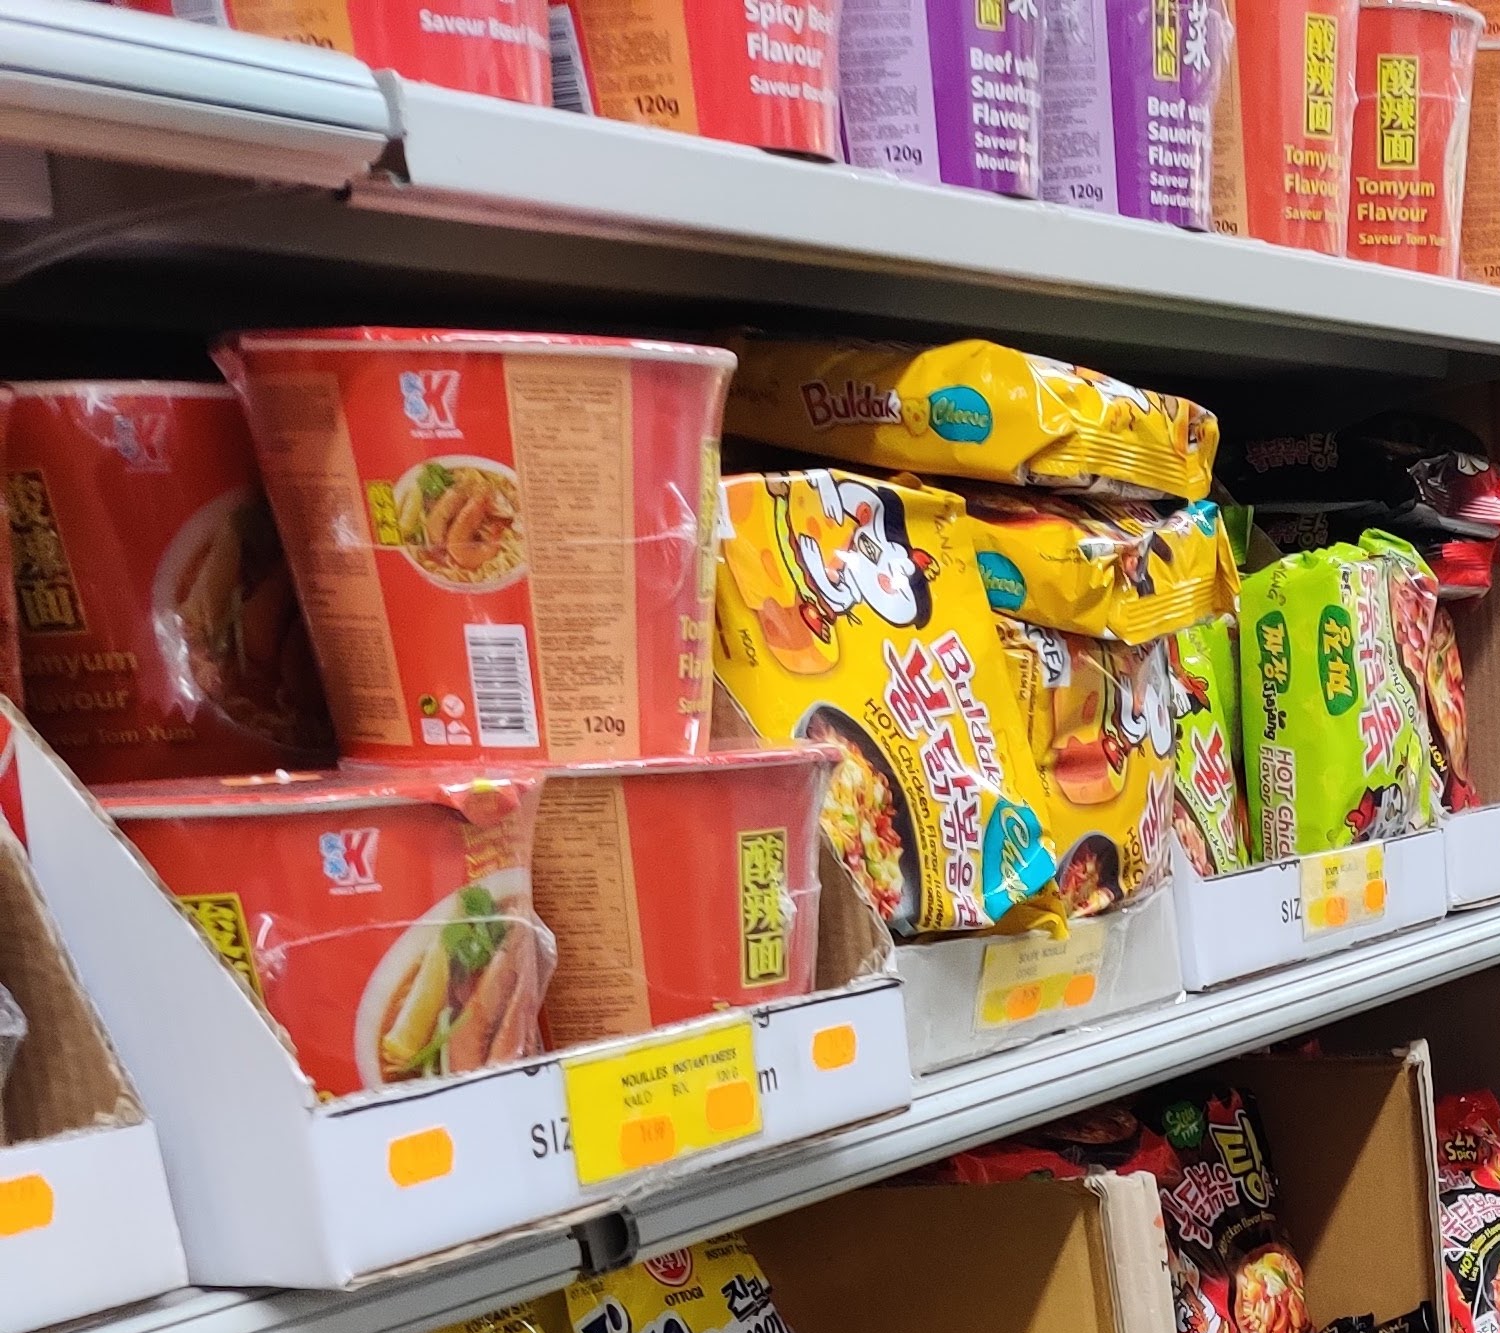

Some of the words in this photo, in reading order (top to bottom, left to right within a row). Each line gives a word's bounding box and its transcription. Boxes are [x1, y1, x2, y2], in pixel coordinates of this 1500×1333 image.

[419, 8, 486, 36] Saveur
[747, 31, 823, 67] Flavour
[969, 47, 1013, 75] Beef
[633, 95, 680, 119] 120g
[1147, 96, 1185, 119] Beef
[885, 145, 923, 165] 120g
[1070, 184, 1104, 200] 120g
[1356, 177, 1436, 202] Tomyum
[1357, 203, 1429, 225] Flavour
[1358, 232, 1402, 248] Saveur
[801, 381, 902, 429] Buldak
[935, 634, 1001, 784] Buldak
[583, 713, 626, 737] 120g
[864, 697, 902, 741] HOT
[899, 743, 931, 820] Chicken
[1260, 746, 1276, 806] Flavor
[1277, 750, 1294, 802] HOT
[663, 1286, 705, 1307] OTTOGI
